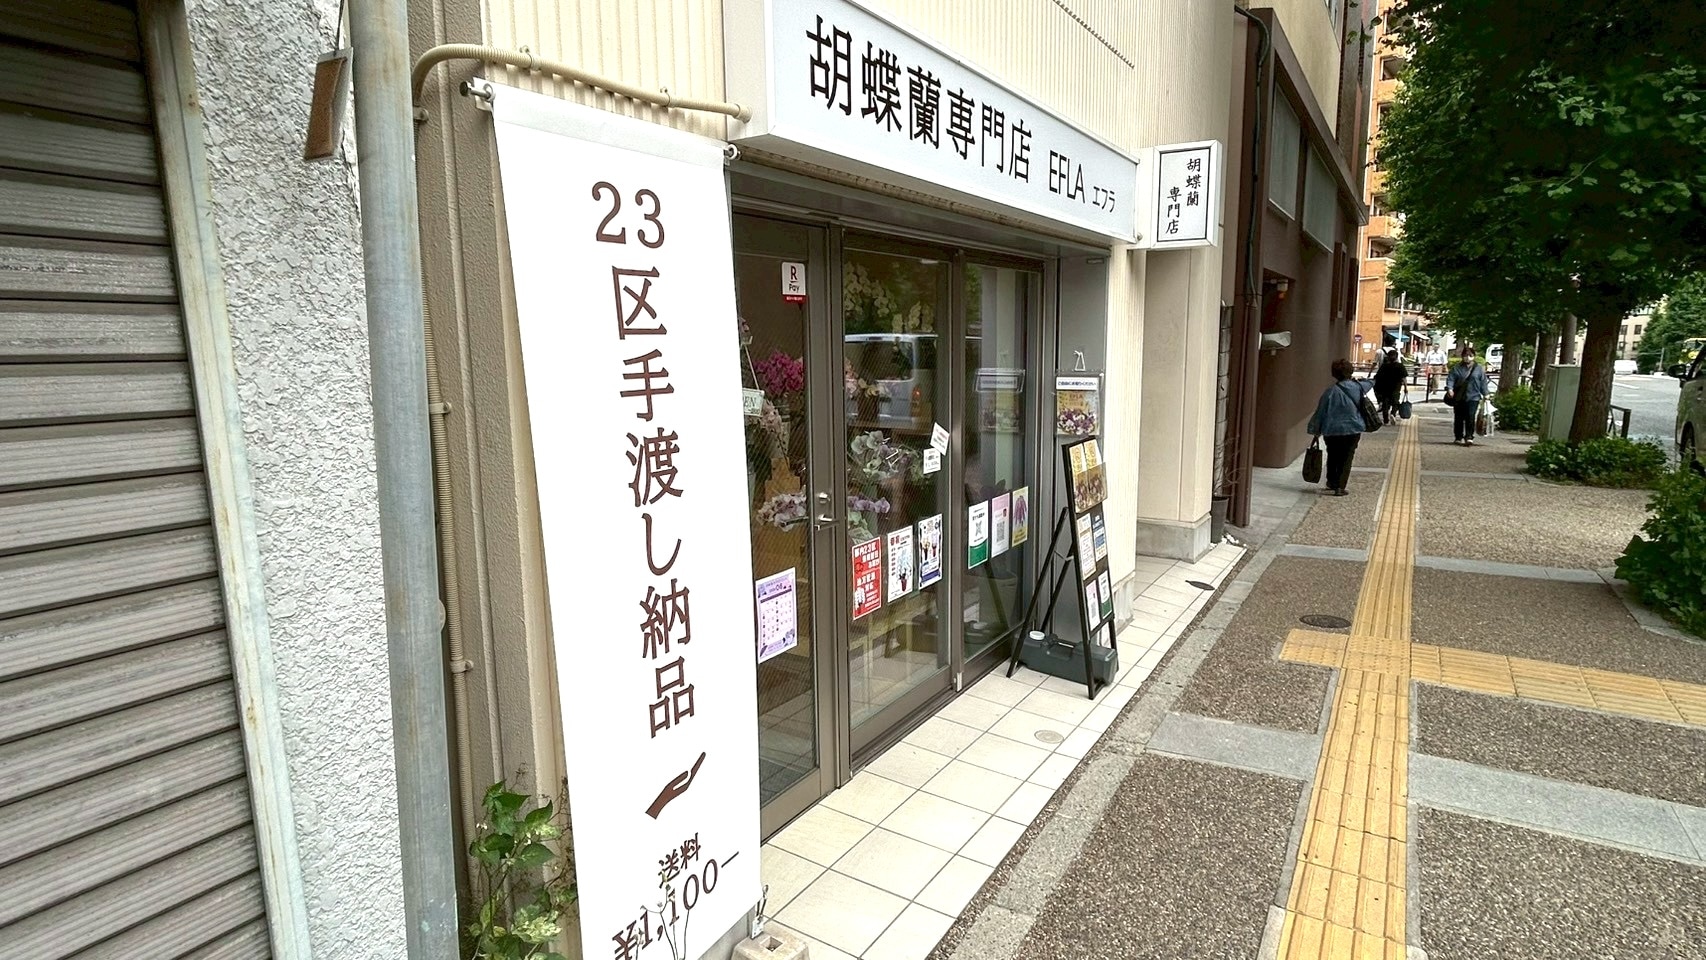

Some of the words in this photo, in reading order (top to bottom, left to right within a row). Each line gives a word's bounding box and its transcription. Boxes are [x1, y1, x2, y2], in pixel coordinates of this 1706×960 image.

[805, 14, 1033, 184] 胡蝶蘭専門店
[1049, 149, 1085, 204] EFLA
[1092, 185, 1116, 213] エフラ
[1185, 157, 1202, 207] 胡蝶蘭
[1165, 186, 1182, 235] 専門店
[788, 283, 800, 294] Pay
[591, 180, 695, 739] 23区手渡し納品
[658, 831, 702, 889] 送料
